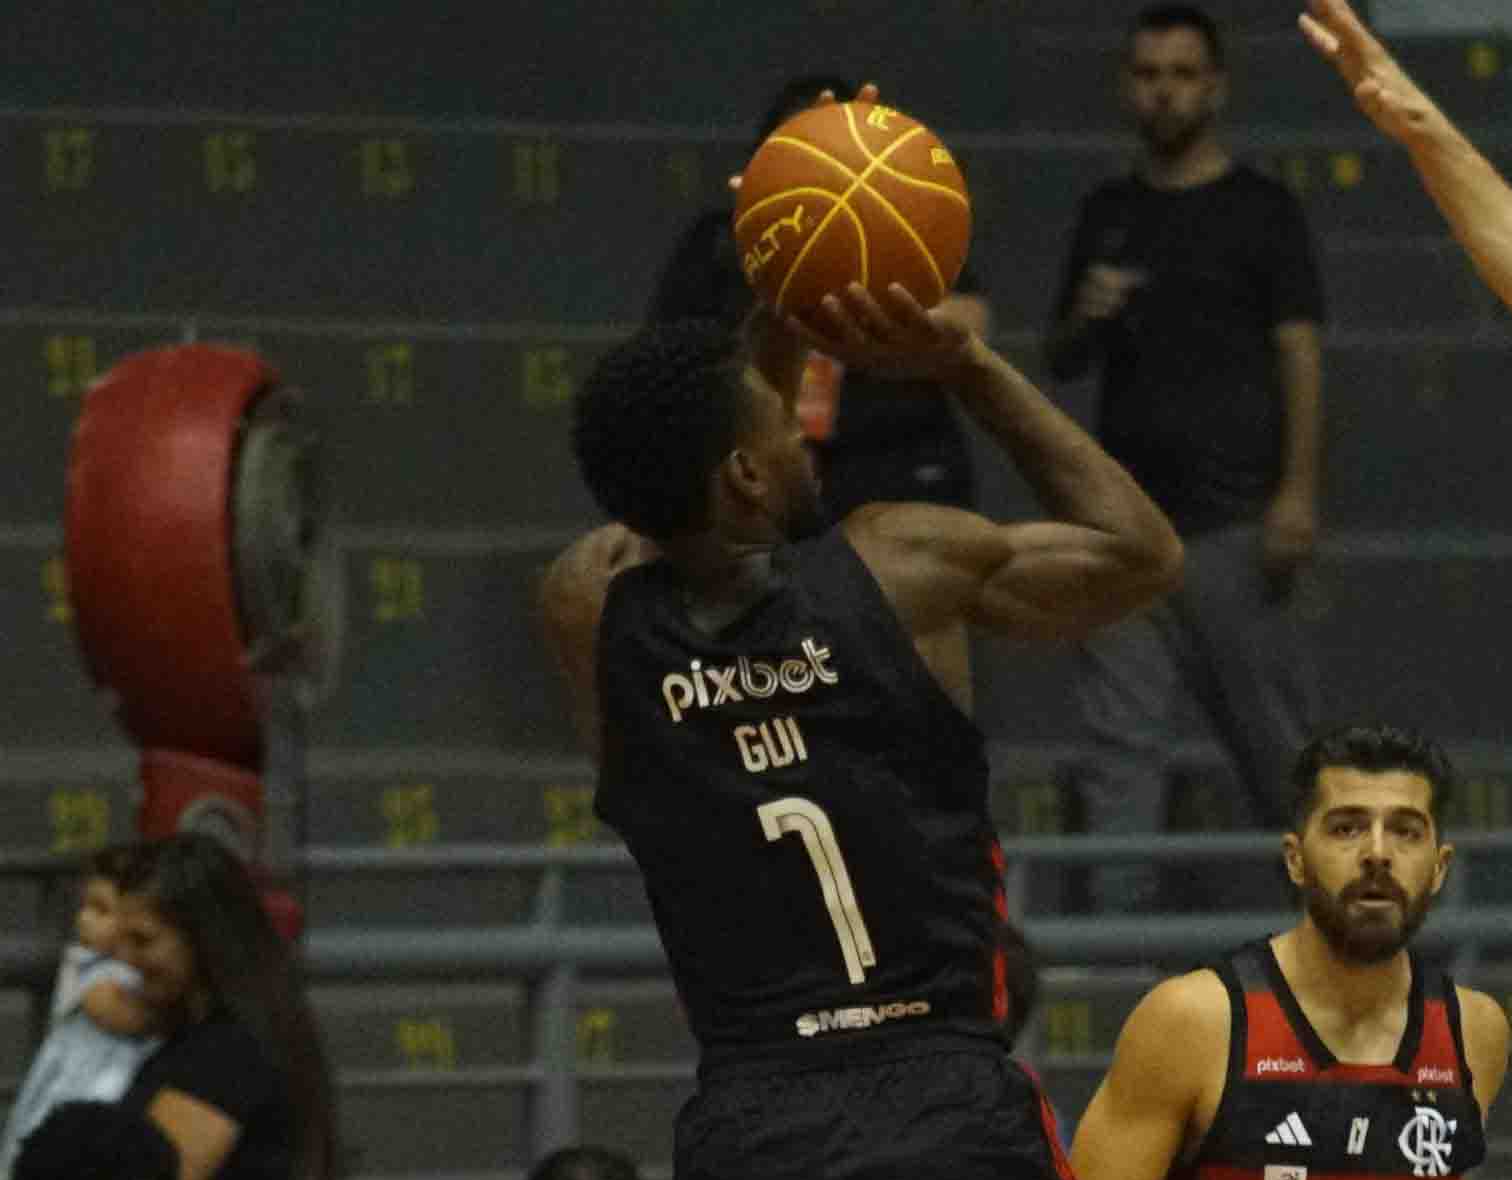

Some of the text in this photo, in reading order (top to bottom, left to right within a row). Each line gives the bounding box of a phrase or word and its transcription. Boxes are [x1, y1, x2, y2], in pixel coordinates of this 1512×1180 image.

[662, 637, 839, 722] pixbet
[733, 716, 809, 774] GUI
[1256, 1055, 1306, 1076] pixbet
